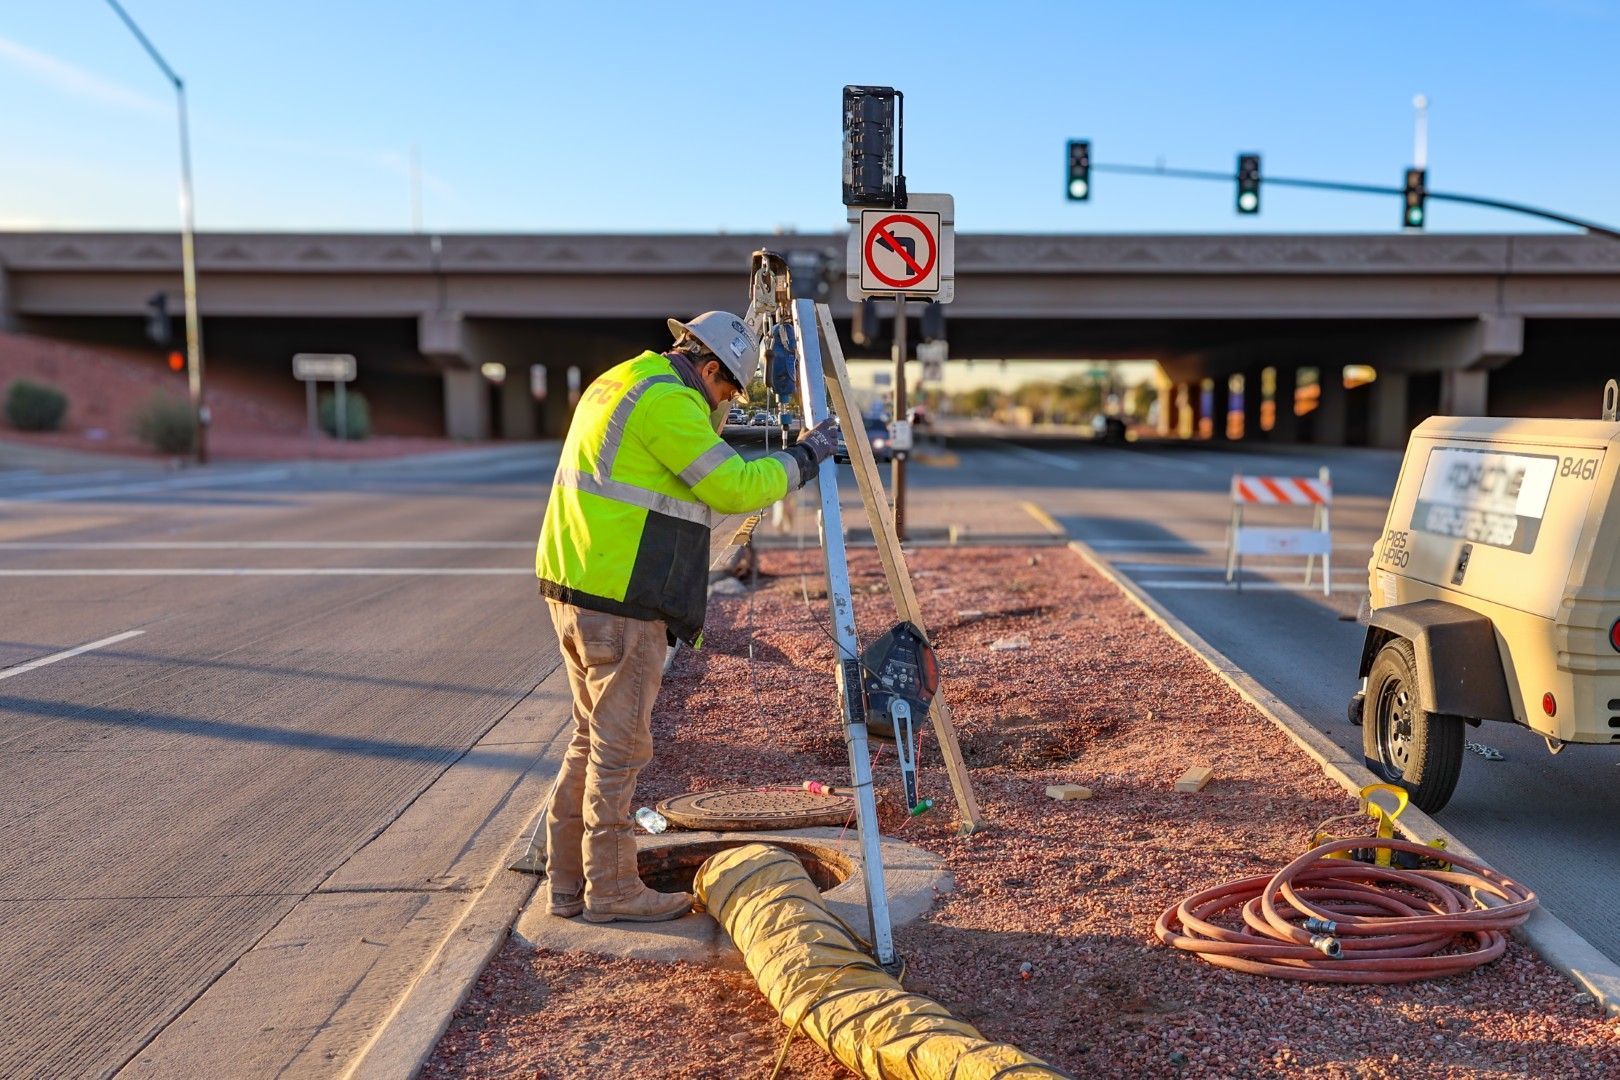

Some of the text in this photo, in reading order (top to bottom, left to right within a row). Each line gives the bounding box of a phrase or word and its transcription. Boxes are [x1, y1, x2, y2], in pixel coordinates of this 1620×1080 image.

[1560, 457, 1598, 480] 8461
[1386, 530, 1408, 549] P185
[1382, 548, 1409, 568] HP150
